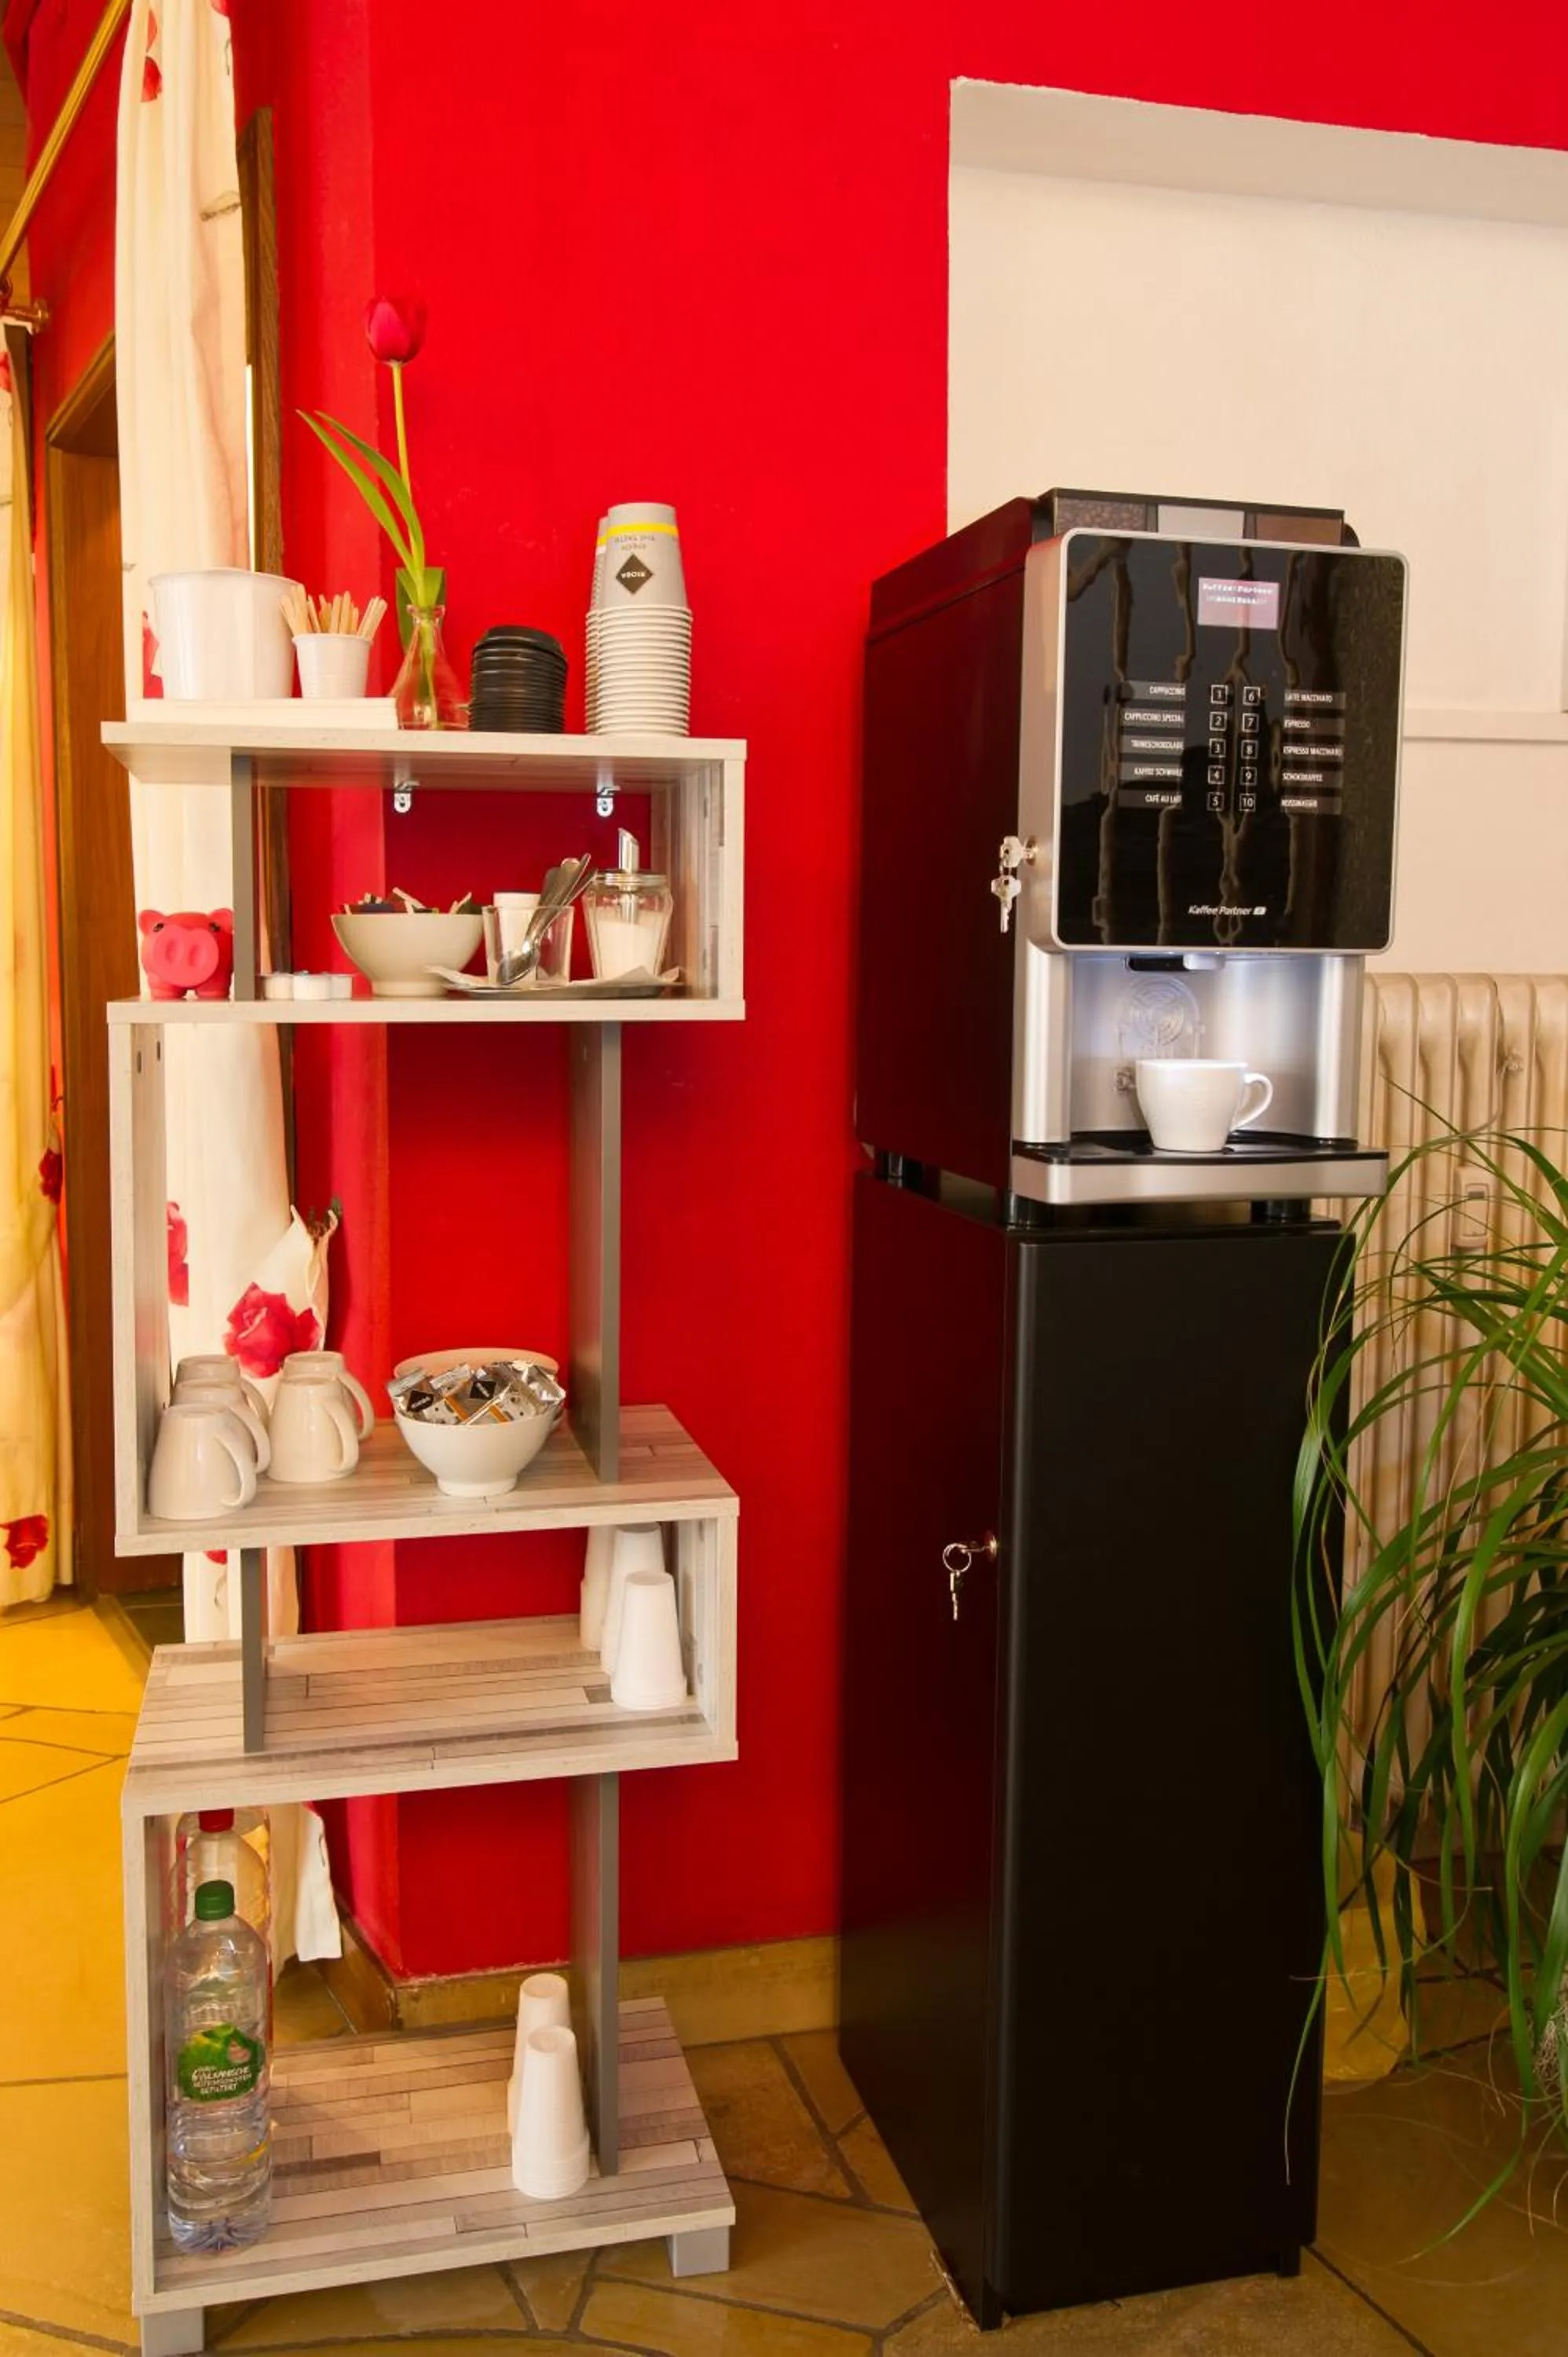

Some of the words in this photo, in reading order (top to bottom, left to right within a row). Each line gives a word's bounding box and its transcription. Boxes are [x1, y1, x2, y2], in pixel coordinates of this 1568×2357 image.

[1149, 685, 1185, 696] CAPPUCCINO
[1248, 693, 1255, 702] 6
[1124, 712, 1161, 721] CAPPUCCINO
[1215, 716, 1222, 725] 2
[1247, 718, 1254, 728] 7
[1214, 744, 1220, 753] 3
[1247, 746, 1253, 755] 8
[1283, 746, 1310, 755] ESPRESSO
[1245, 771, 1251, 780] 9
[1212, 796, 1218, 806] 5
[1243, 797, 1253, 807] 10
[1189, 904, 1218, 915] Kaffee
[1219, 905, 1252, 915] Partner
